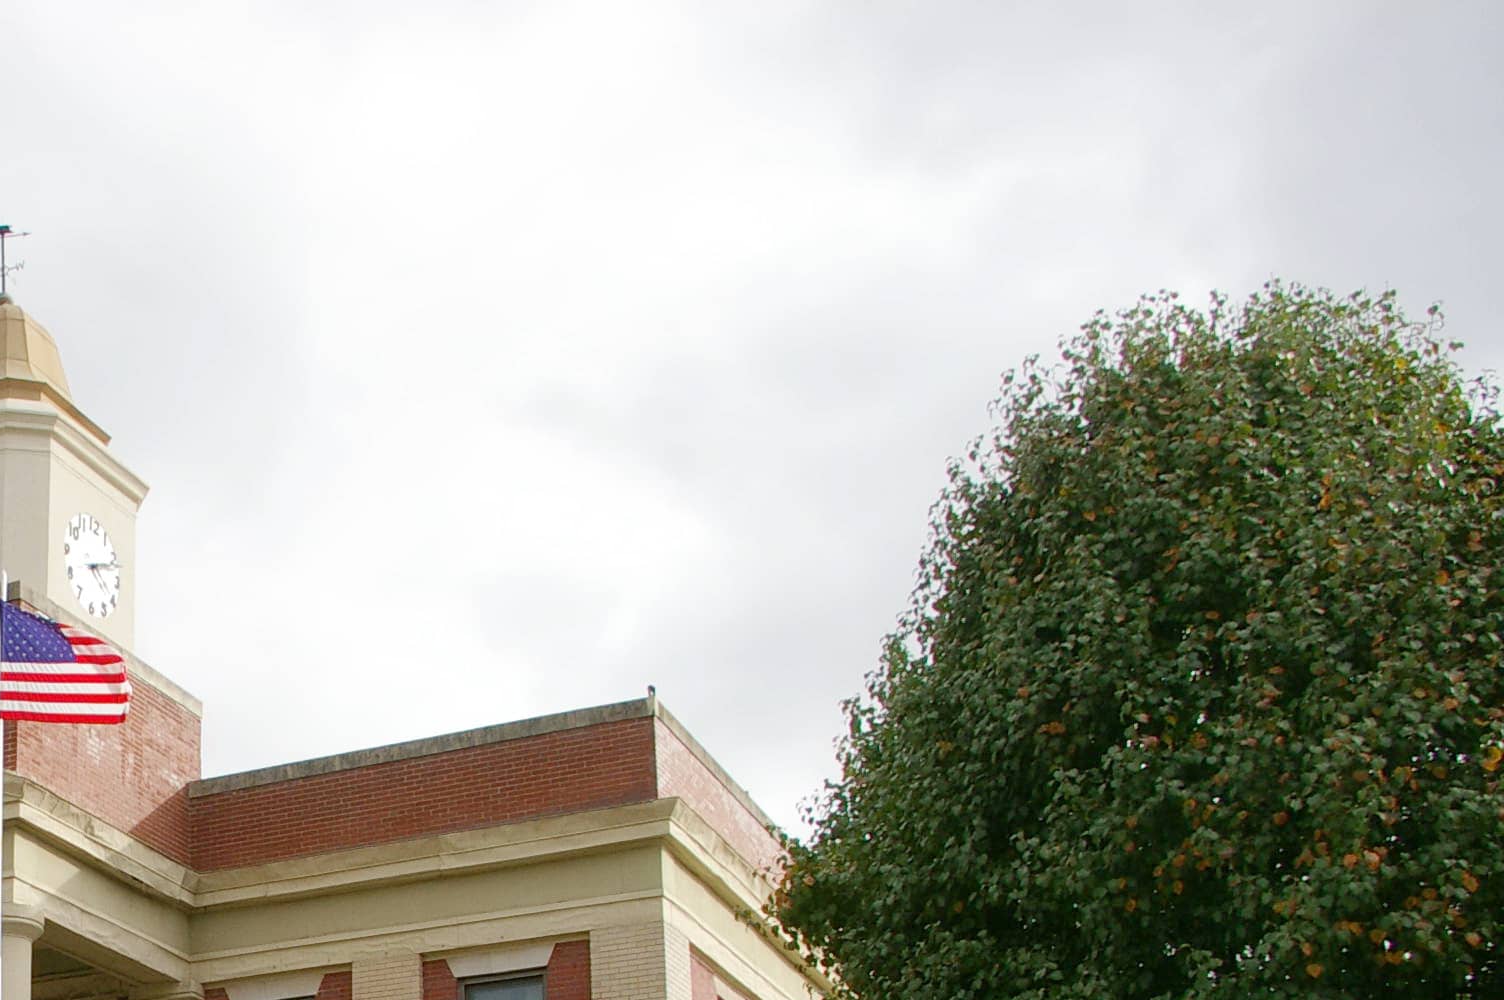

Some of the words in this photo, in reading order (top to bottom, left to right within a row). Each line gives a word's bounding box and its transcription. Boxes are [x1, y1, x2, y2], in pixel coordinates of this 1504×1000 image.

[78, 512, 86, 533] 11
[89, 516, 99, 536] 12
[68, 521, 79, 541] 10
[64, 543, 70, 555] 9
[67, 565, 74, 580] 8
[114, 575, 120, 589] 3
[76, 584, 83, 600] 7
[88, 601, 95, 615] 6
[109, 594, 116, 608] 4
[100, 601, 107, 617] 5
